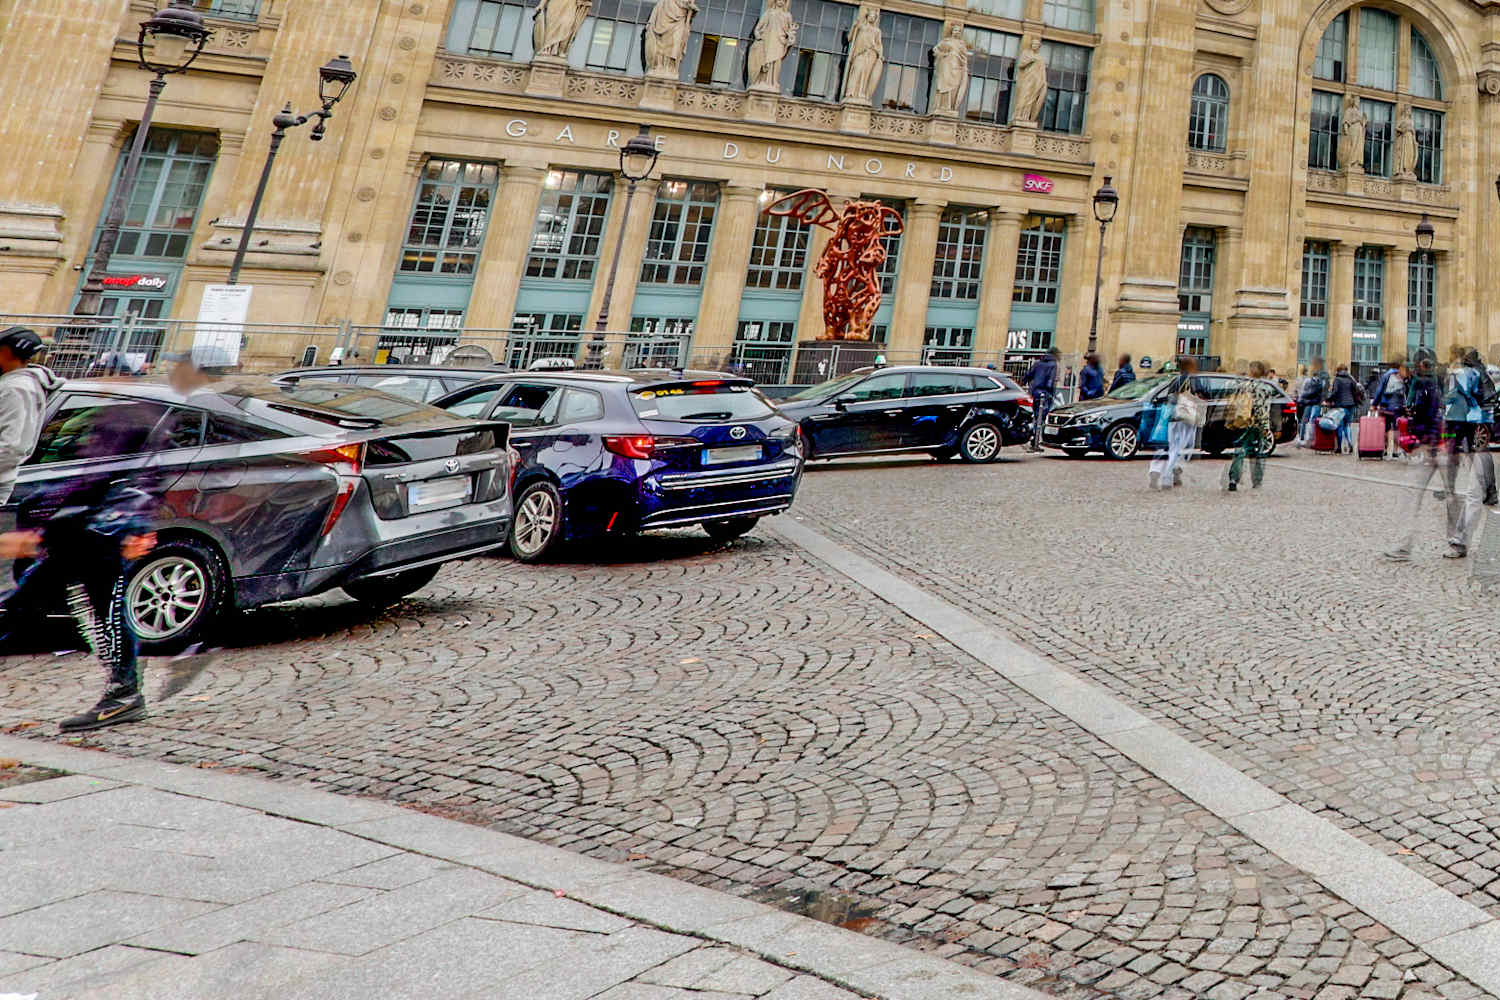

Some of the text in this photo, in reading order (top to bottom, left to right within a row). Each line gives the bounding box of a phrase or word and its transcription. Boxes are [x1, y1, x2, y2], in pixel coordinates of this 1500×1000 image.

[505, 119, 953, 182] GARE DU NORD
[1024, 178, 1053, 192] SNCF
[137, 276, 167, 289] daily
[547, 360, 570, 368] TAXI
